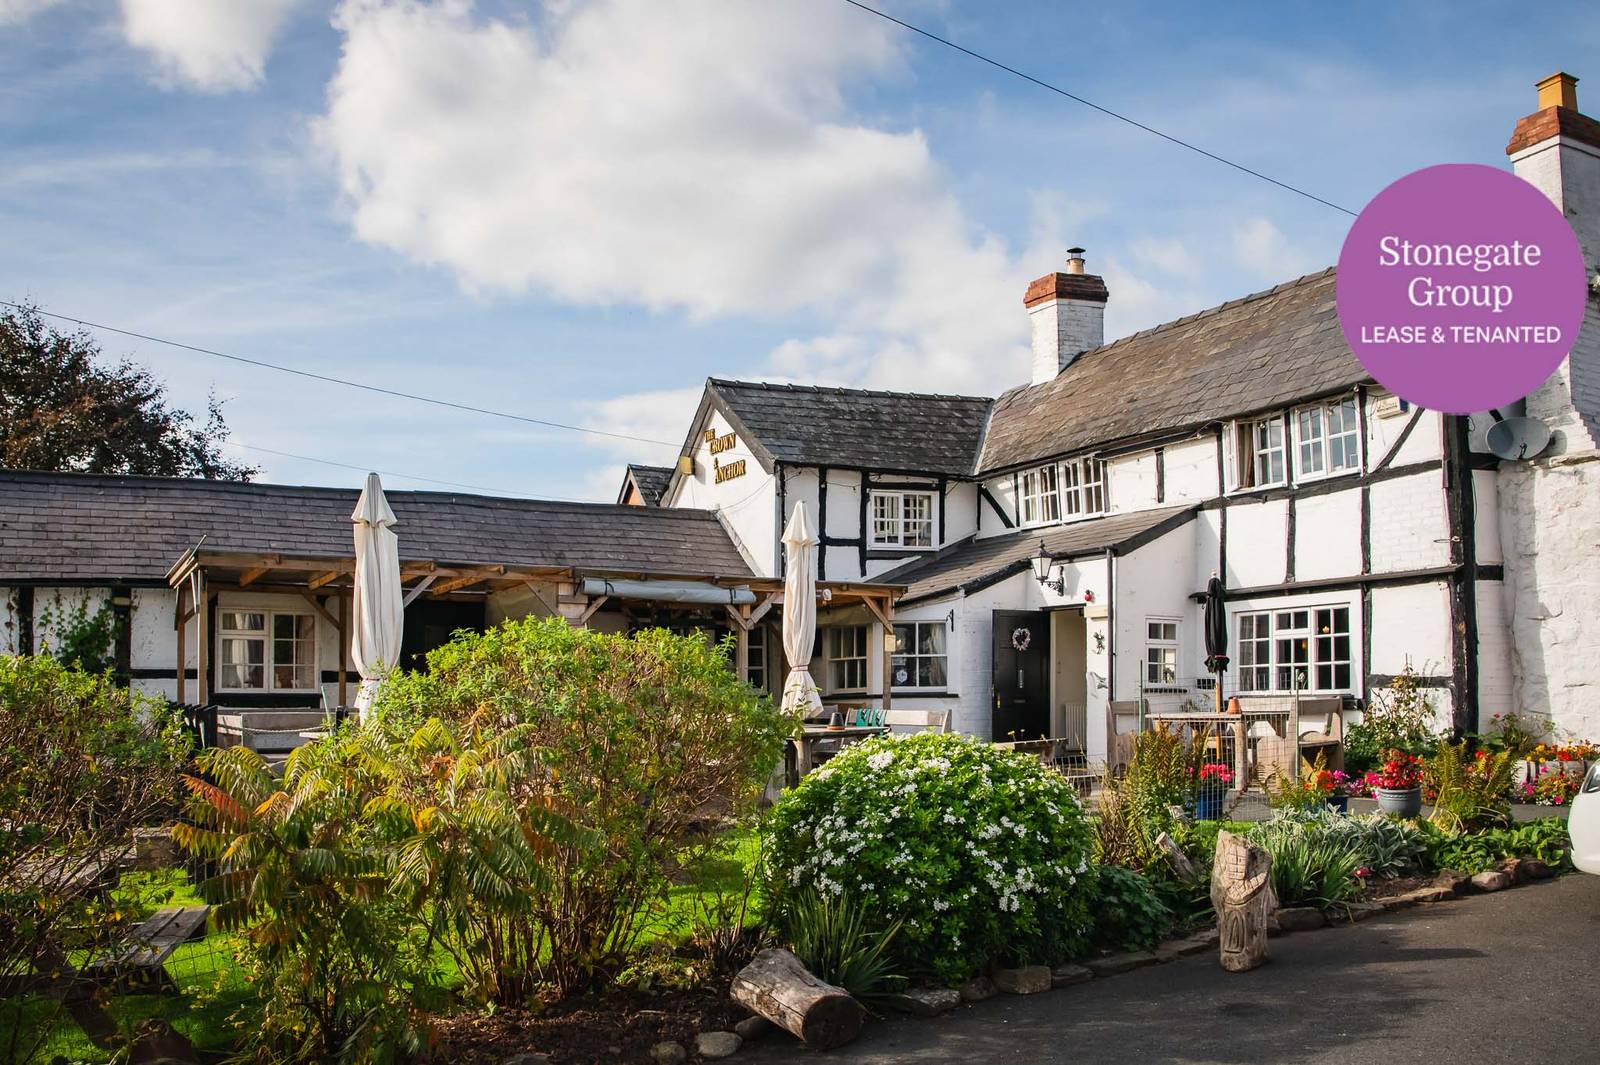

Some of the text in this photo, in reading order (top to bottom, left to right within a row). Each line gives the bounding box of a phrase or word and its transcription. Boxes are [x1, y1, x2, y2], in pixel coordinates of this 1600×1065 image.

[704, 428, 715, 442] THE
[710, 432, 736, 455] CROWN
[715, 459, 746, 484] ANCHOR
